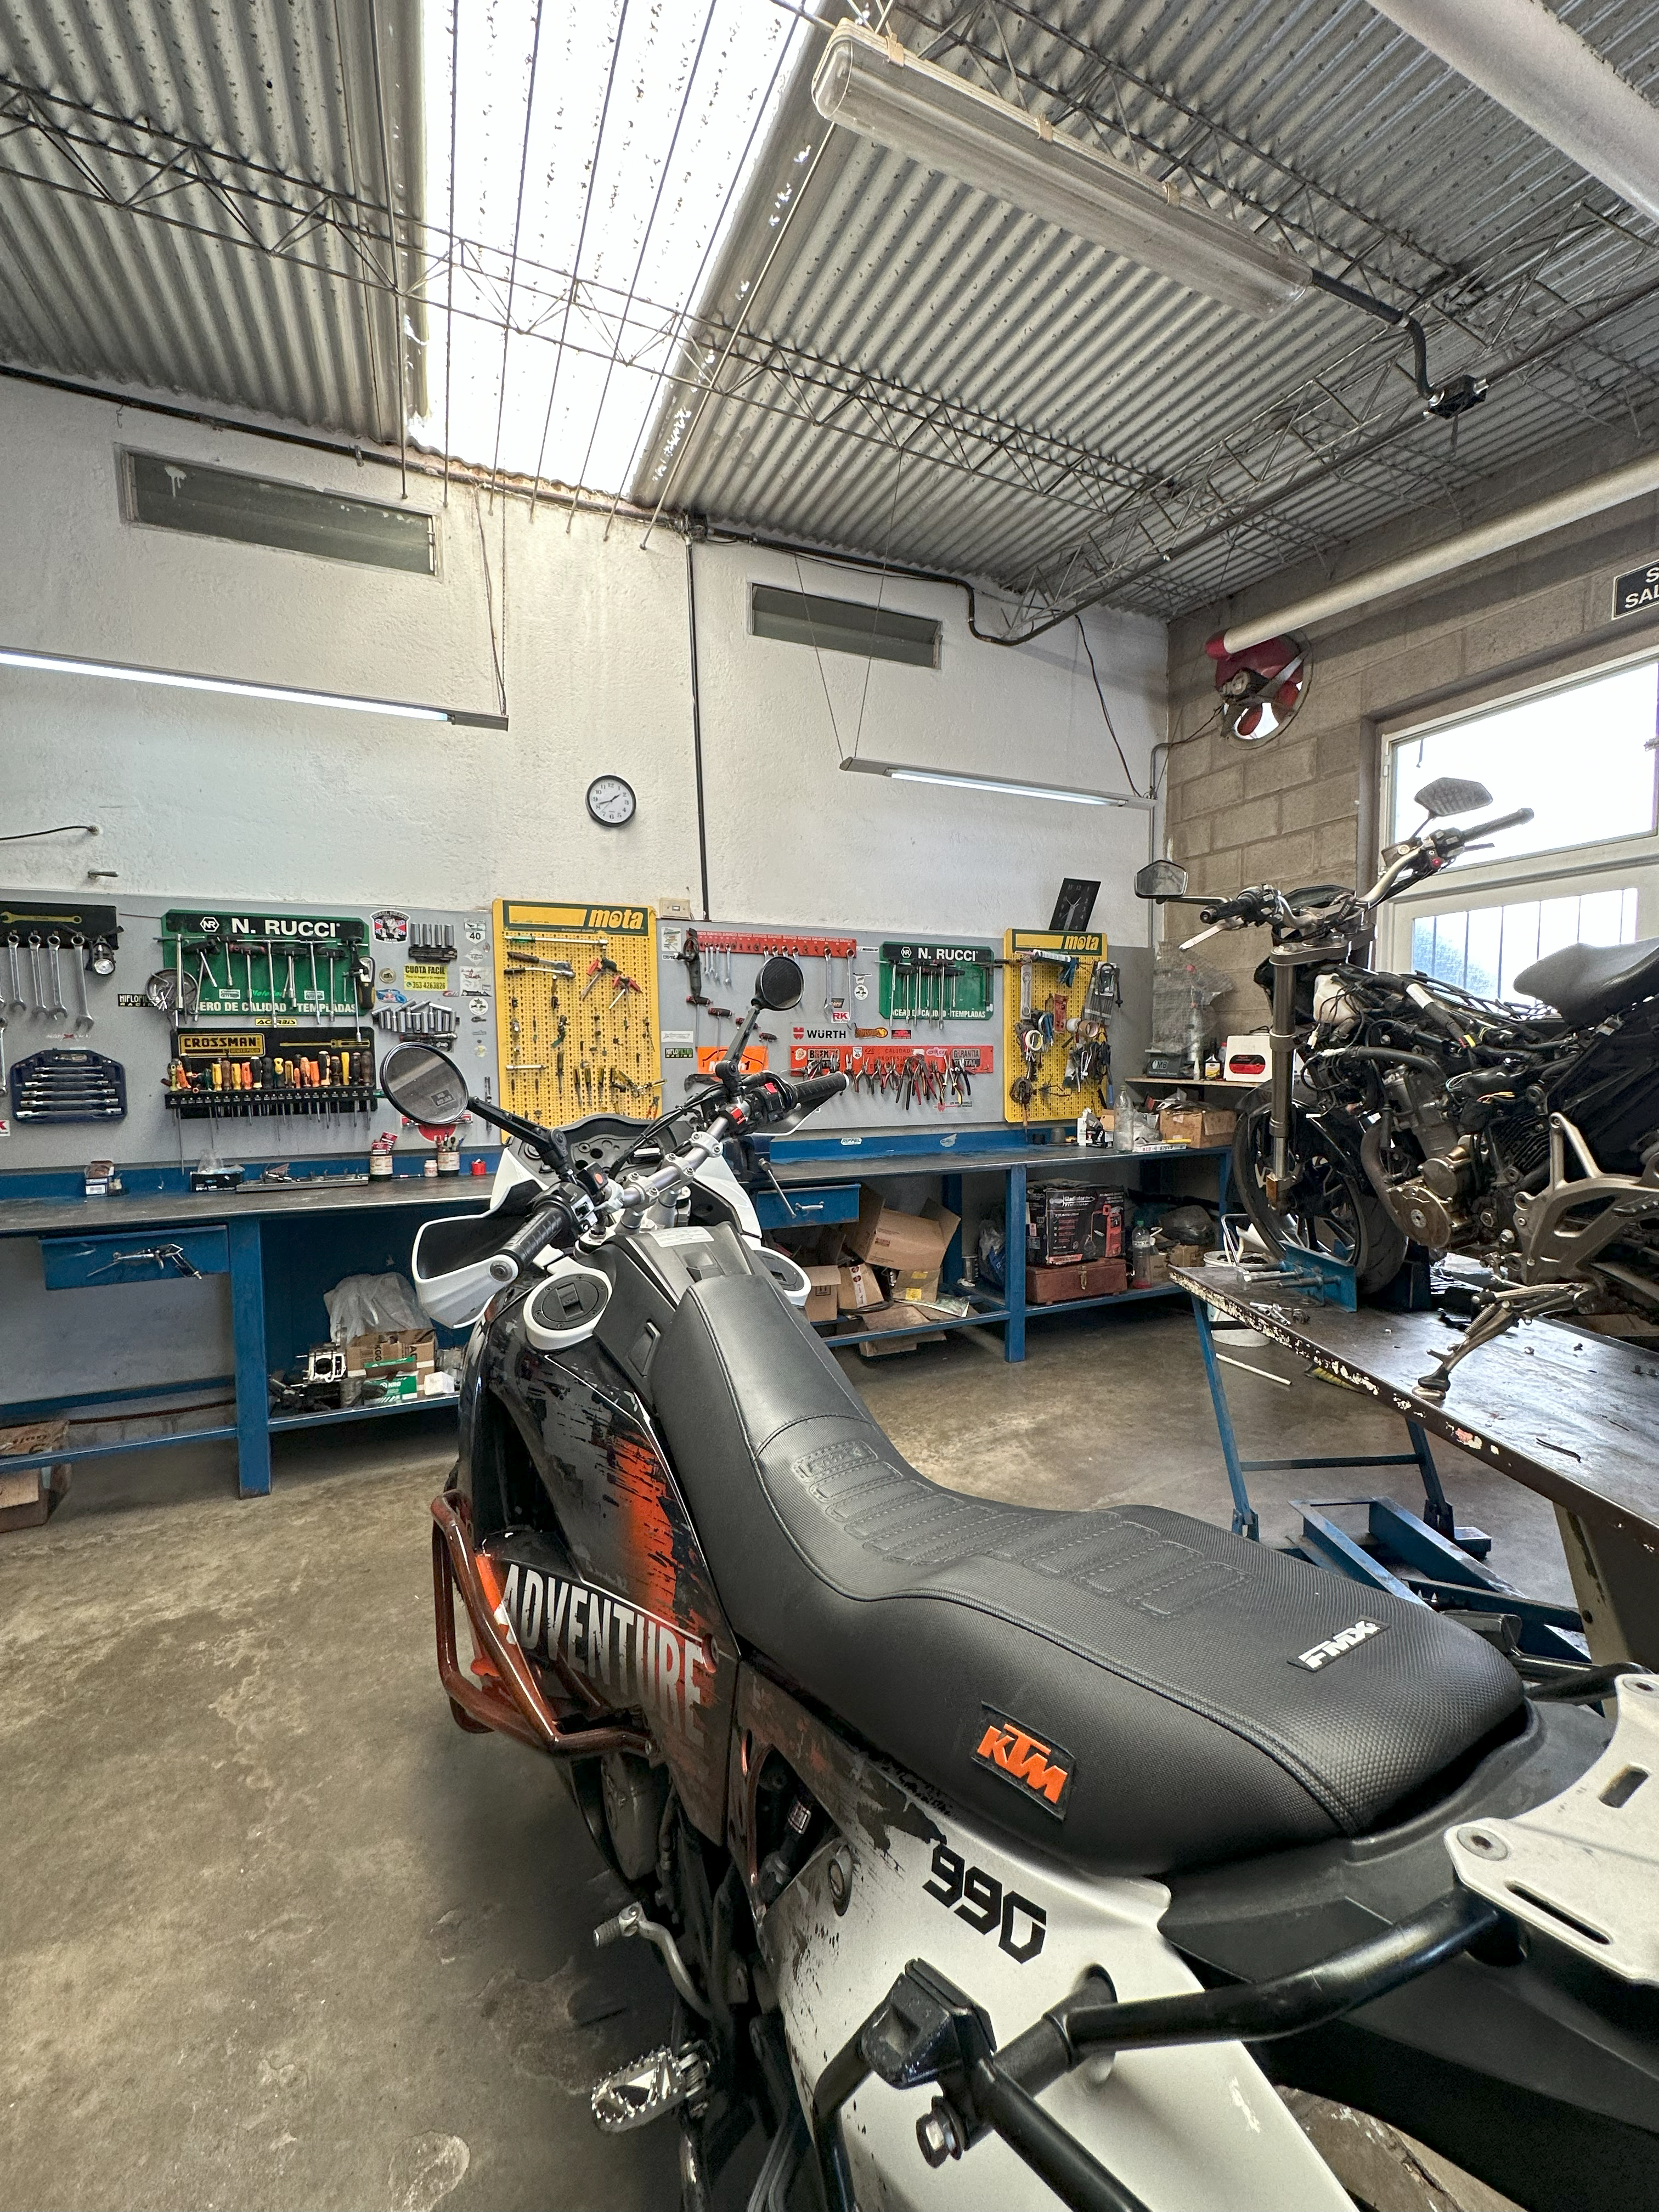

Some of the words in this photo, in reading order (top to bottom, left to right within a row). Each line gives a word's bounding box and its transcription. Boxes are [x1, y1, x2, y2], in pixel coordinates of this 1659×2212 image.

[202, 919, 217, 929] NR
[232, 918, 256, 933] N.
[264, 919, 336, 937] RUCCI
[588, 910, 644, 929] mota
[1064, 935, 1099, 951] mota
[918, 947, 932, 959] N.
[936, 949, 976, 961] RUCCI
[405, 966, 426, 974] CUOTA
[224, 1002, 238, 1012] DE
[297, 1003, 356, 1013] TEMPLADAS
[184, 1037, 257, 1047] CROSSMAN
[953, 1049, 979, 1058] GARANTIA
[1298, 1621, 1380, 1668] FMX
[499, 1564, 704, 1749] ADVENTURE
[977, 1723, 1068, 1804] KTM
[922, 1843, 1047, 1965] 990
